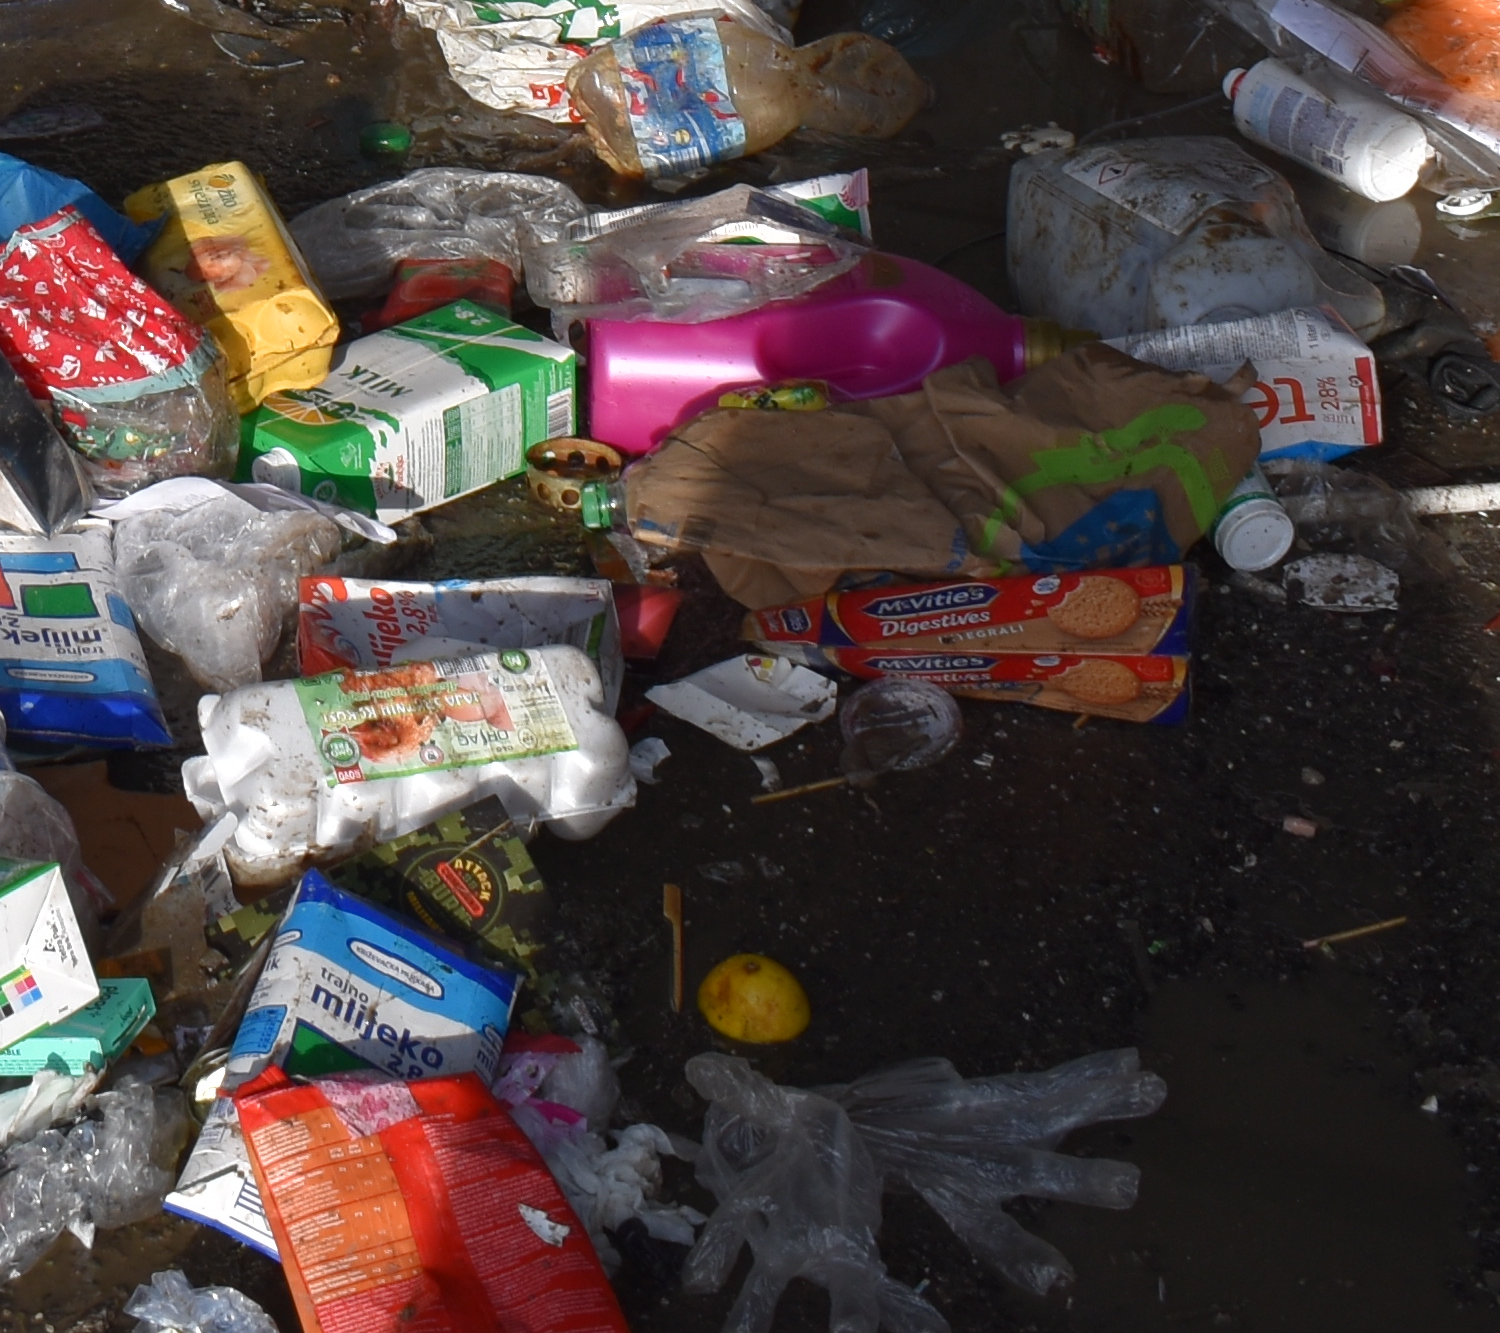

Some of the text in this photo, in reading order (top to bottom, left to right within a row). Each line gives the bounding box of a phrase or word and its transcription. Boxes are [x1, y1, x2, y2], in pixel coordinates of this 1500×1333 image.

[338, 363, 413, 398] MILK
[1317, 376, 1340, 411] 2.8%
[405, 590, 433, 636] 2,8%
[875, 586, 987, 615] McVitie's
[360, 587, 395, 671] ijeko
[880, 607, 991, 638] Digestives
[445, 692, 481, 706] JAJA
[320, 966, 370, 1004] trajno
[310, 983, 444, 1070] mlijeko
